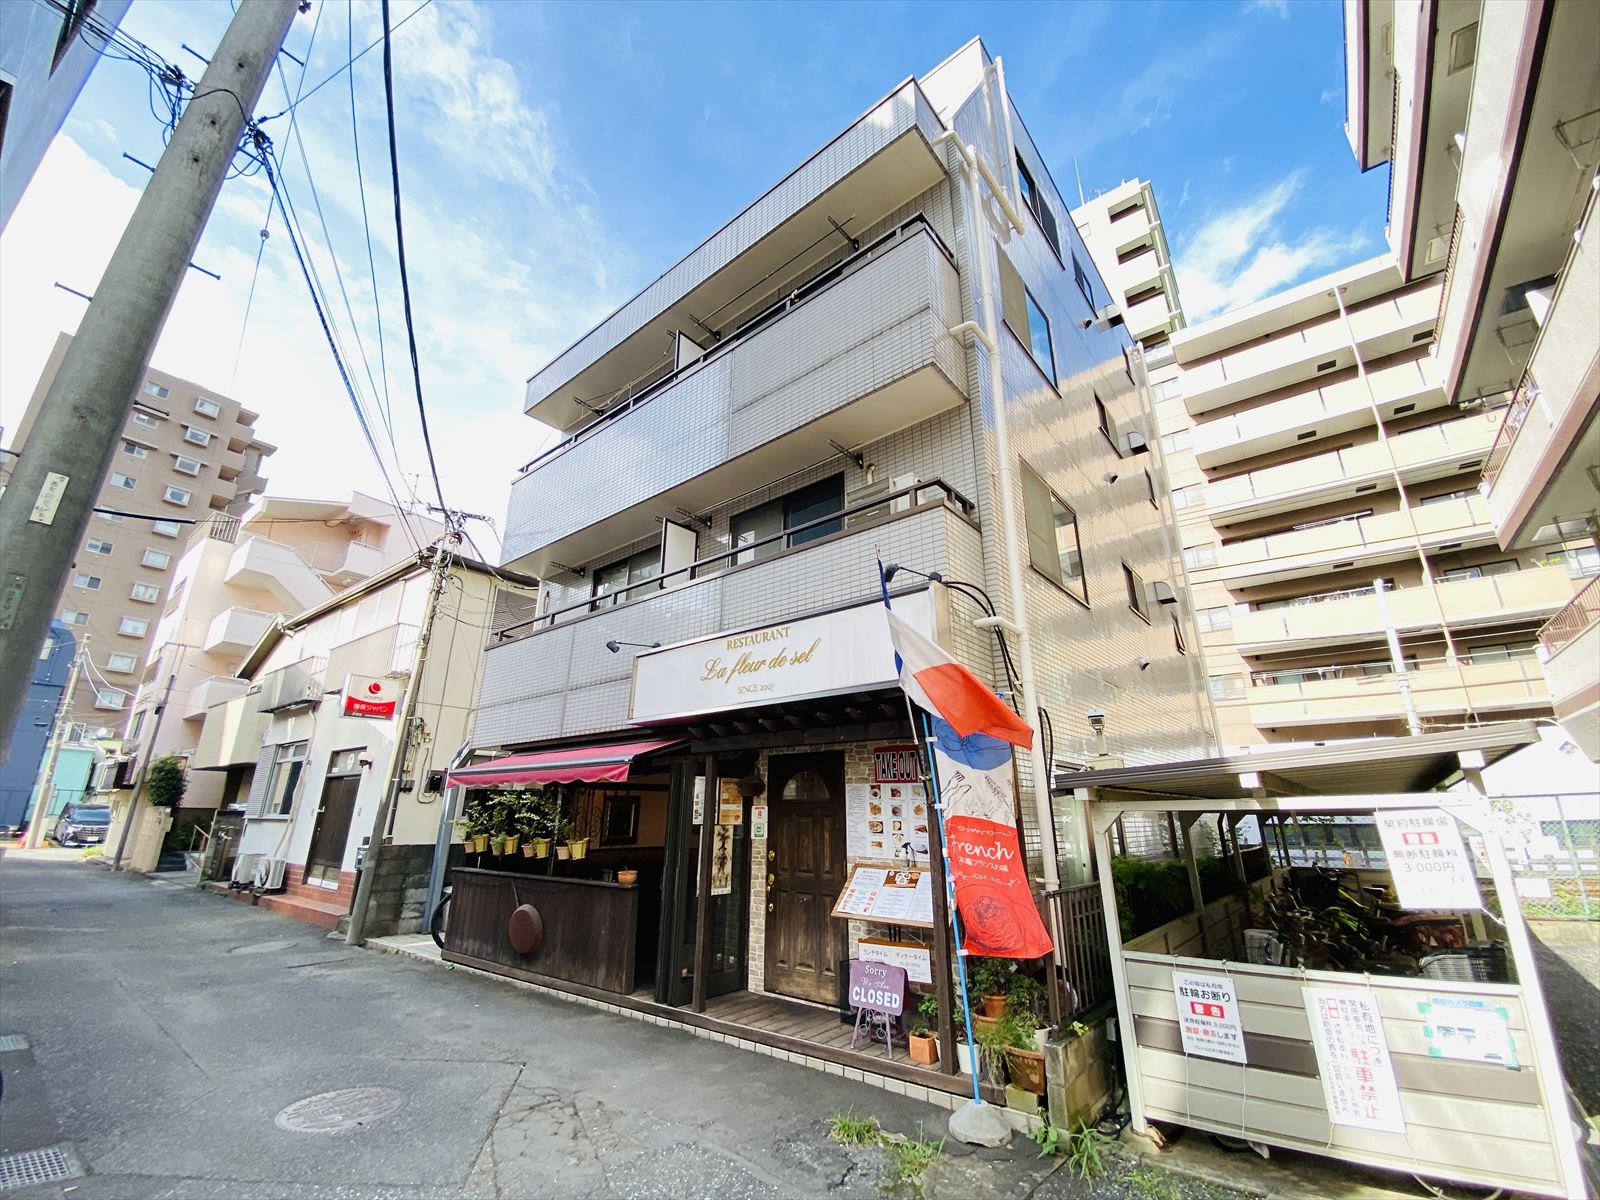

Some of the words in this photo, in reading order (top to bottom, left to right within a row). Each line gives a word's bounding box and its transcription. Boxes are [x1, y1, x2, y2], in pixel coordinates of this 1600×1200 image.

[726, 626, 791, 650] RESTAURANT
[700, 657, 727, 681] La
[724, 650, 767, 684] fleur
[768, 647, 788, 669] de
[790, 637, 821, 664] sel
[737, 684, 759, 694] SINCE
[875, 751, 897, 780] TAKE
[898, 751, 917, 780] OUT
[864, 965, 888, 978] Sorry
[852, 986, 900, 1008] CLOSED
[1179, 986, 1231, 1003] 駐輪お断り
